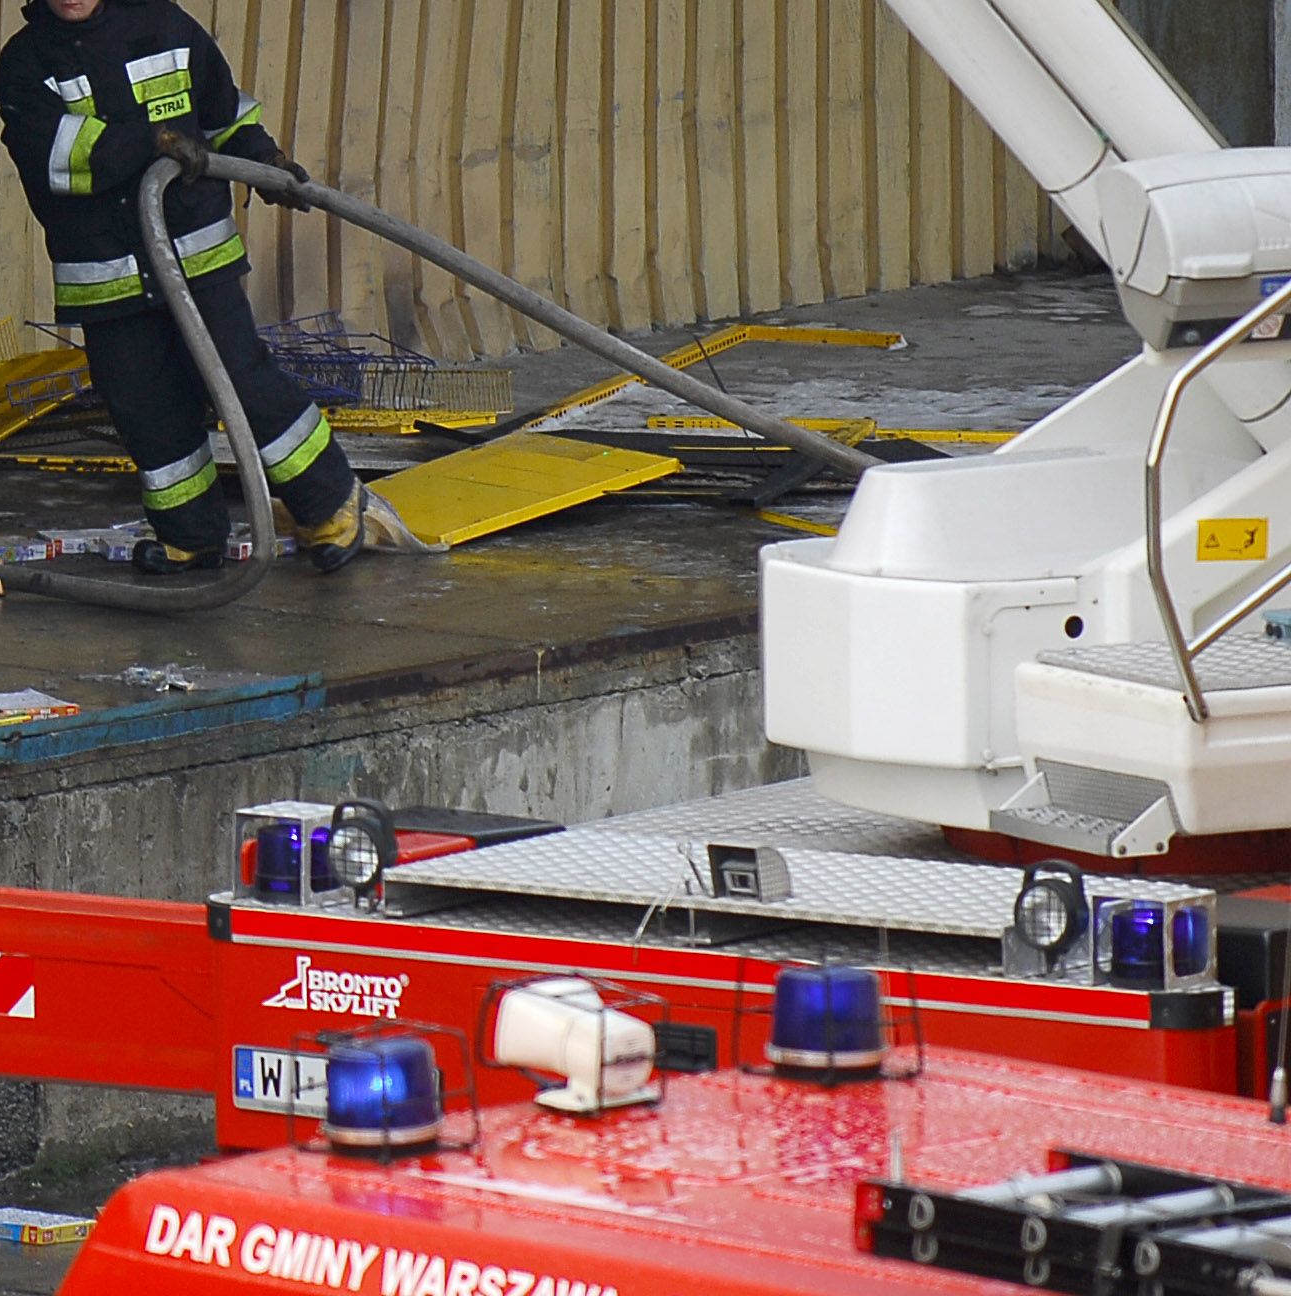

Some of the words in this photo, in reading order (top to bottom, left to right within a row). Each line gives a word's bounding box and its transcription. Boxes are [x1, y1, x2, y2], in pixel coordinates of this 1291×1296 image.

[308, 970, 402, 999] BRONTO
[310, 991, 400, 1019] SKYLIFT
[145, 1204, 238, 1268] DAR
[240, 1223, 380, 1292] GMINY
[381, 1247, 618, 1296] WARSZ
